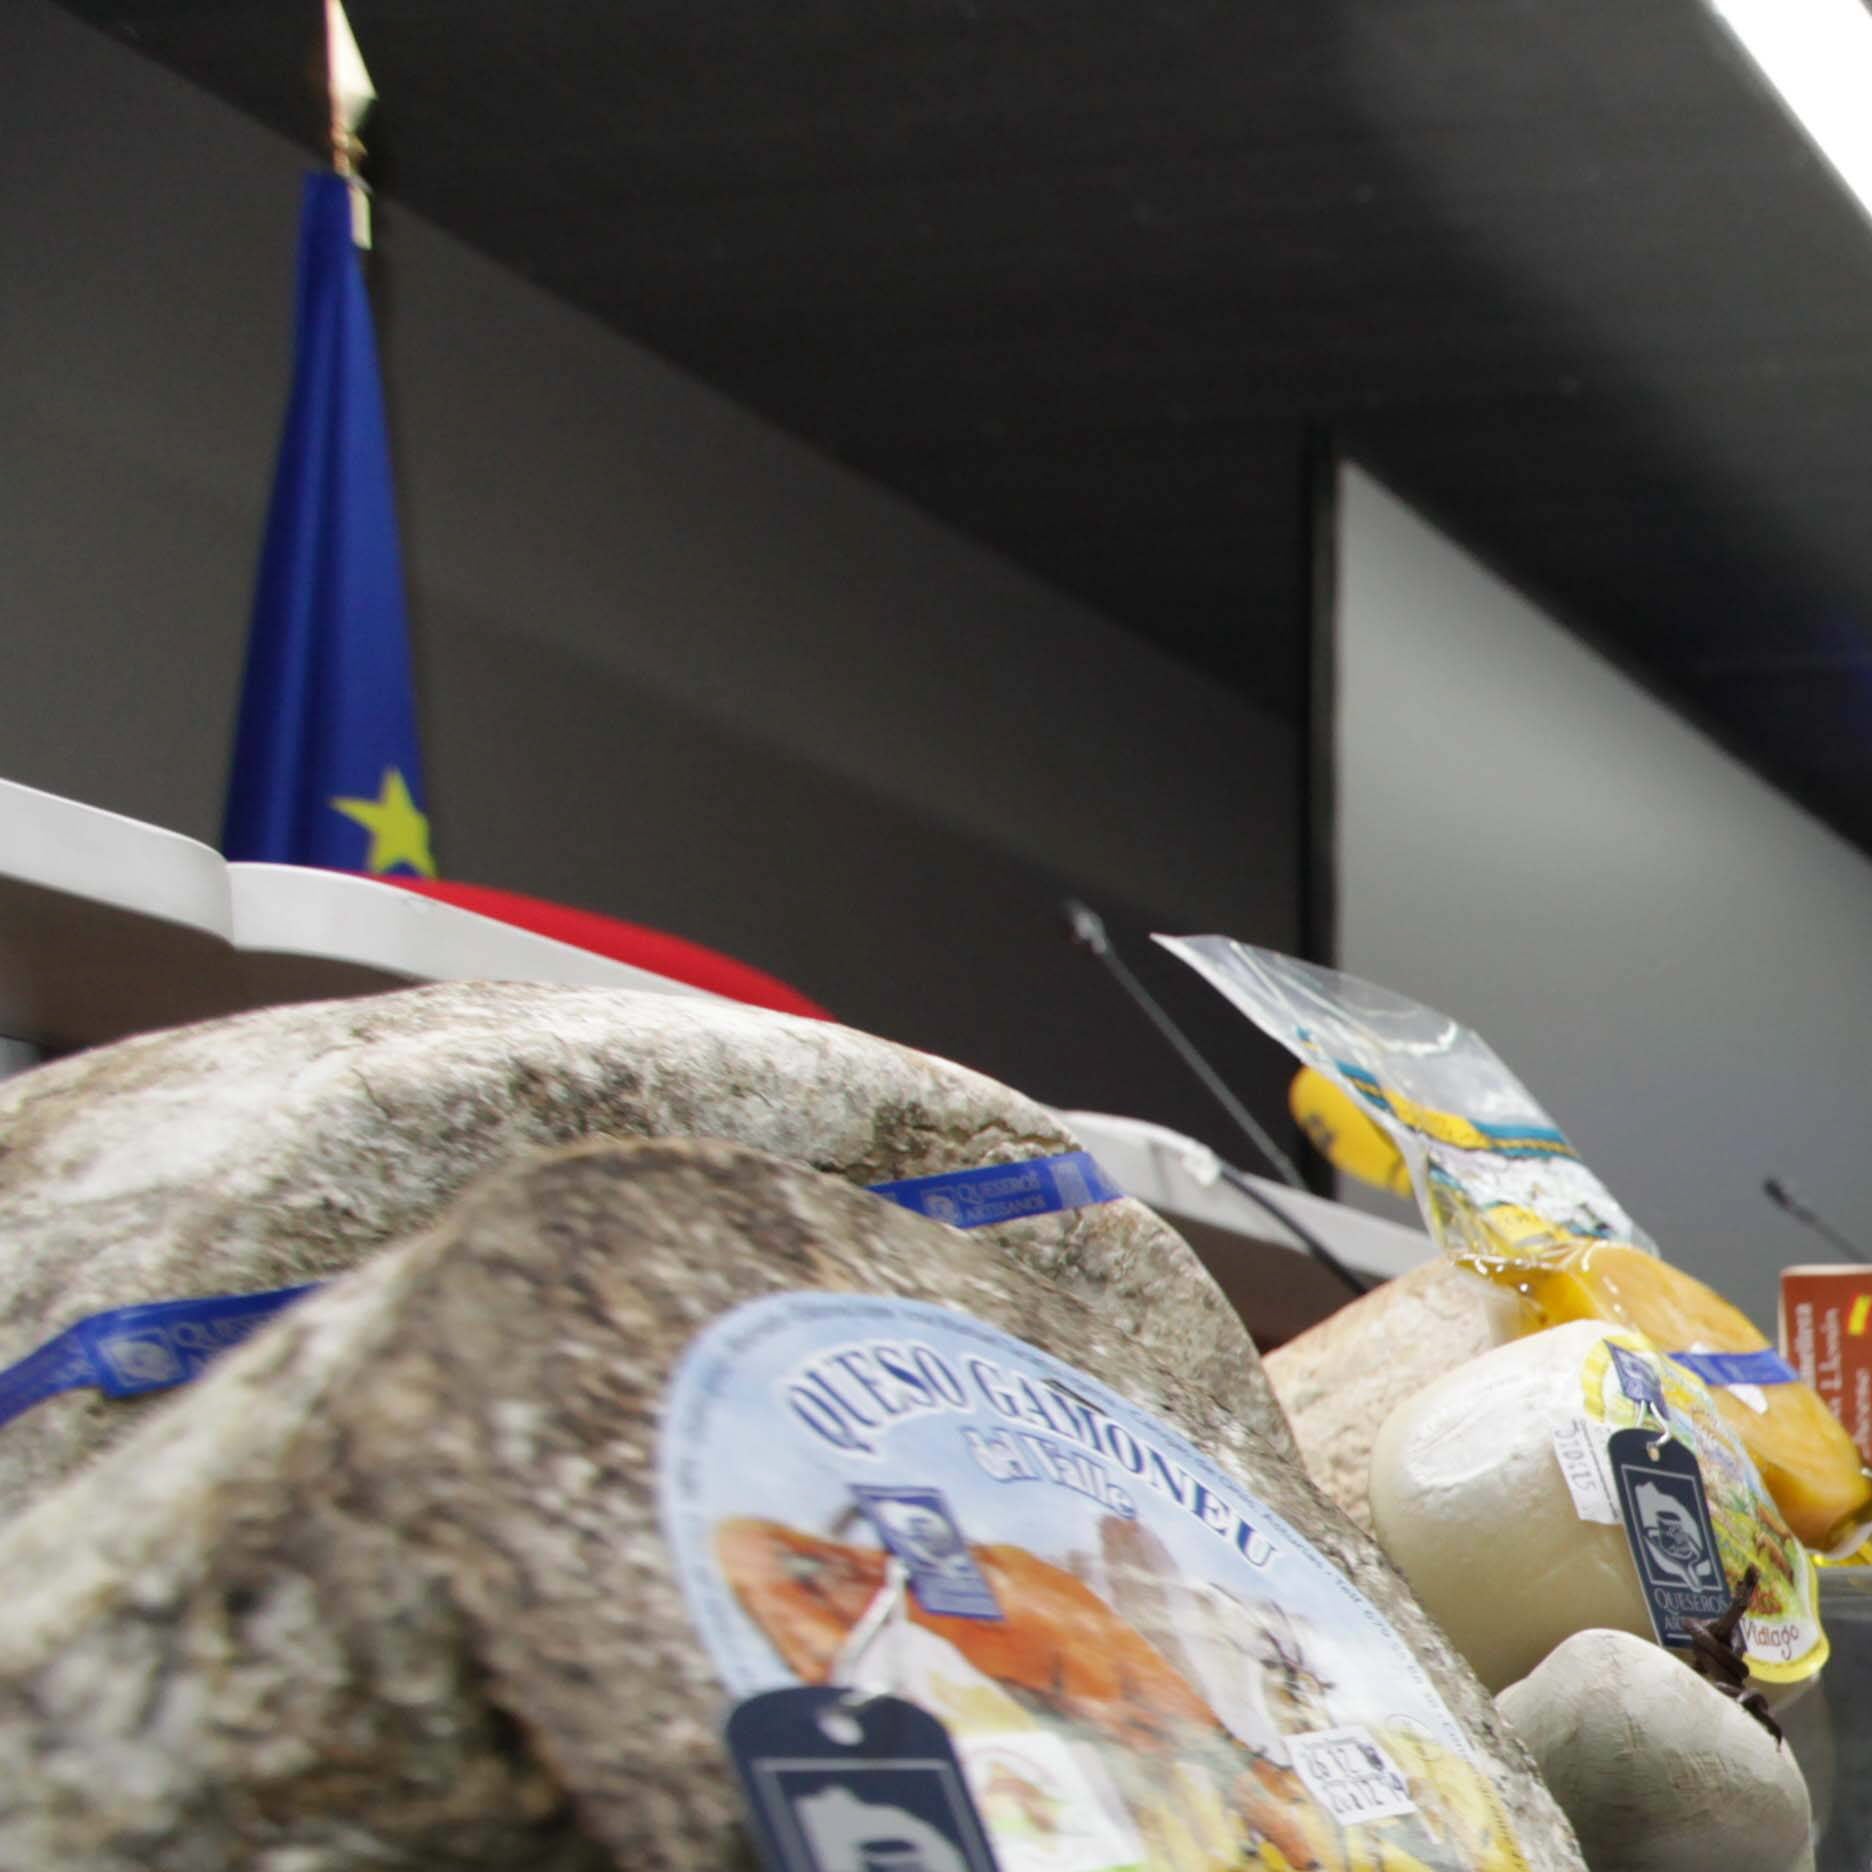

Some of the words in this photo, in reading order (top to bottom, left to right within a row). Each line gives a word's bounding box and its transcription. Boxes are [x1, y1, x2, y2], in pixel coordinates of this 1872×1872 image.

[788, 1345, 968, 1455] QUESO
[969, 1358, 1278, 1568] GAMONEU
[1024, 1431, 1137, 1520] Valle
[1654, 1585, 1730, 1616] QUESEROS
